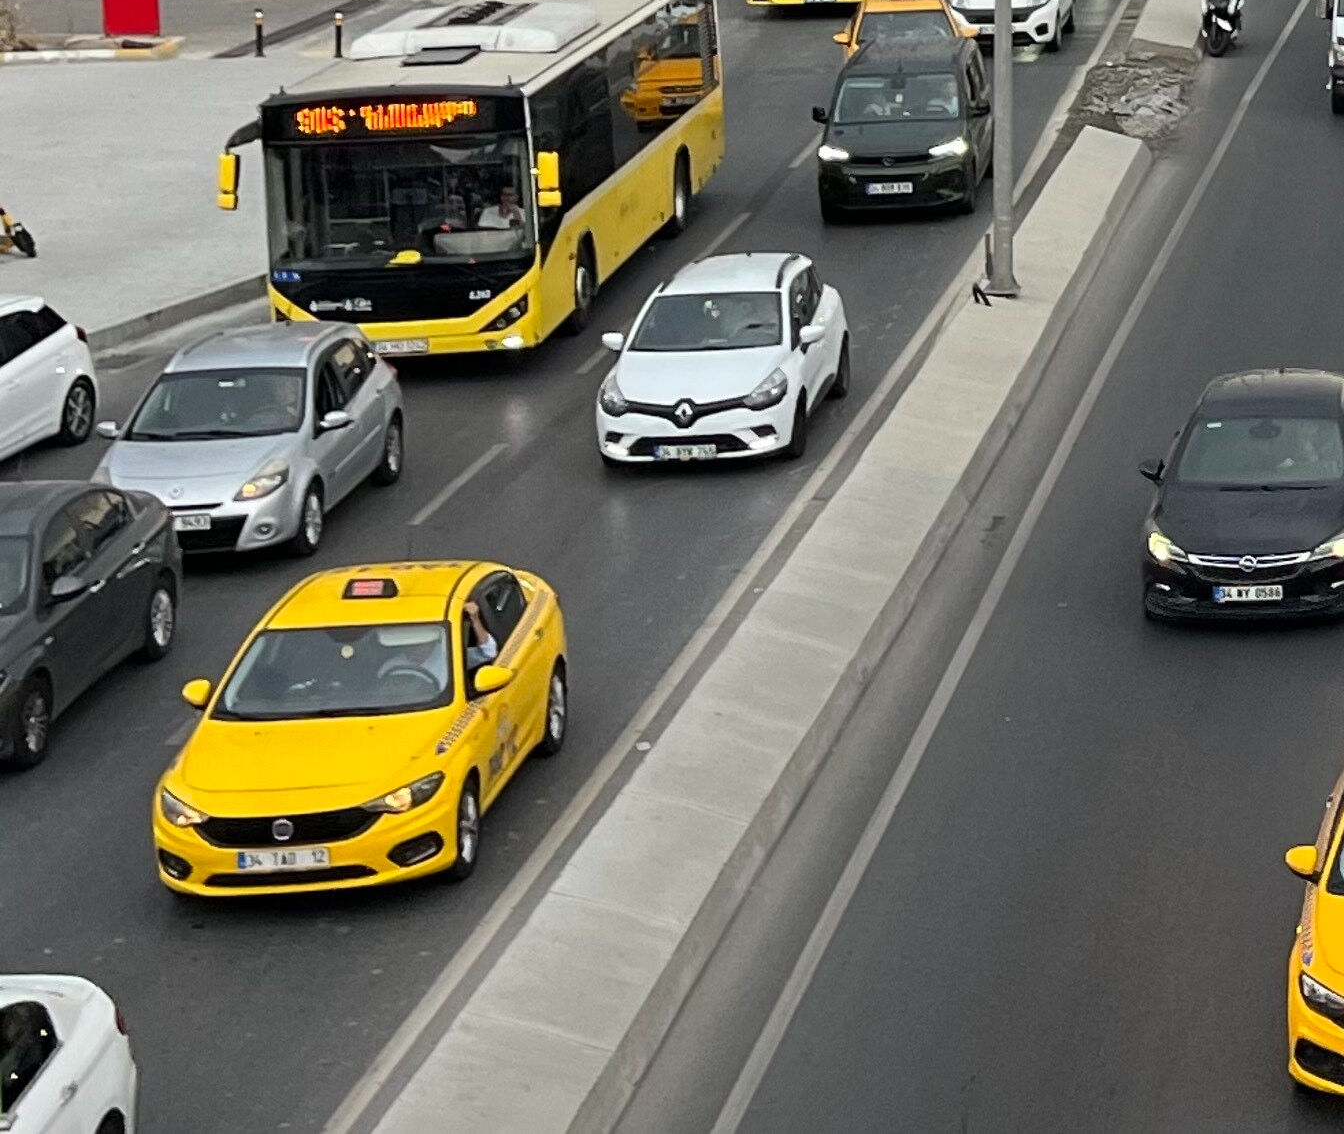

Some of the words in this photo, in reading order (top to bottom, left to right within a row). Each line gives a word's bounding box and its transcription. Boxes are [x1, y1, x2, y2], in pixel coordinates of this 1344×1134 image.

[1221, 587, 1233, 599] 34
[247, 855, 263, 868] 34
[311, 850, 326, 863] 12
